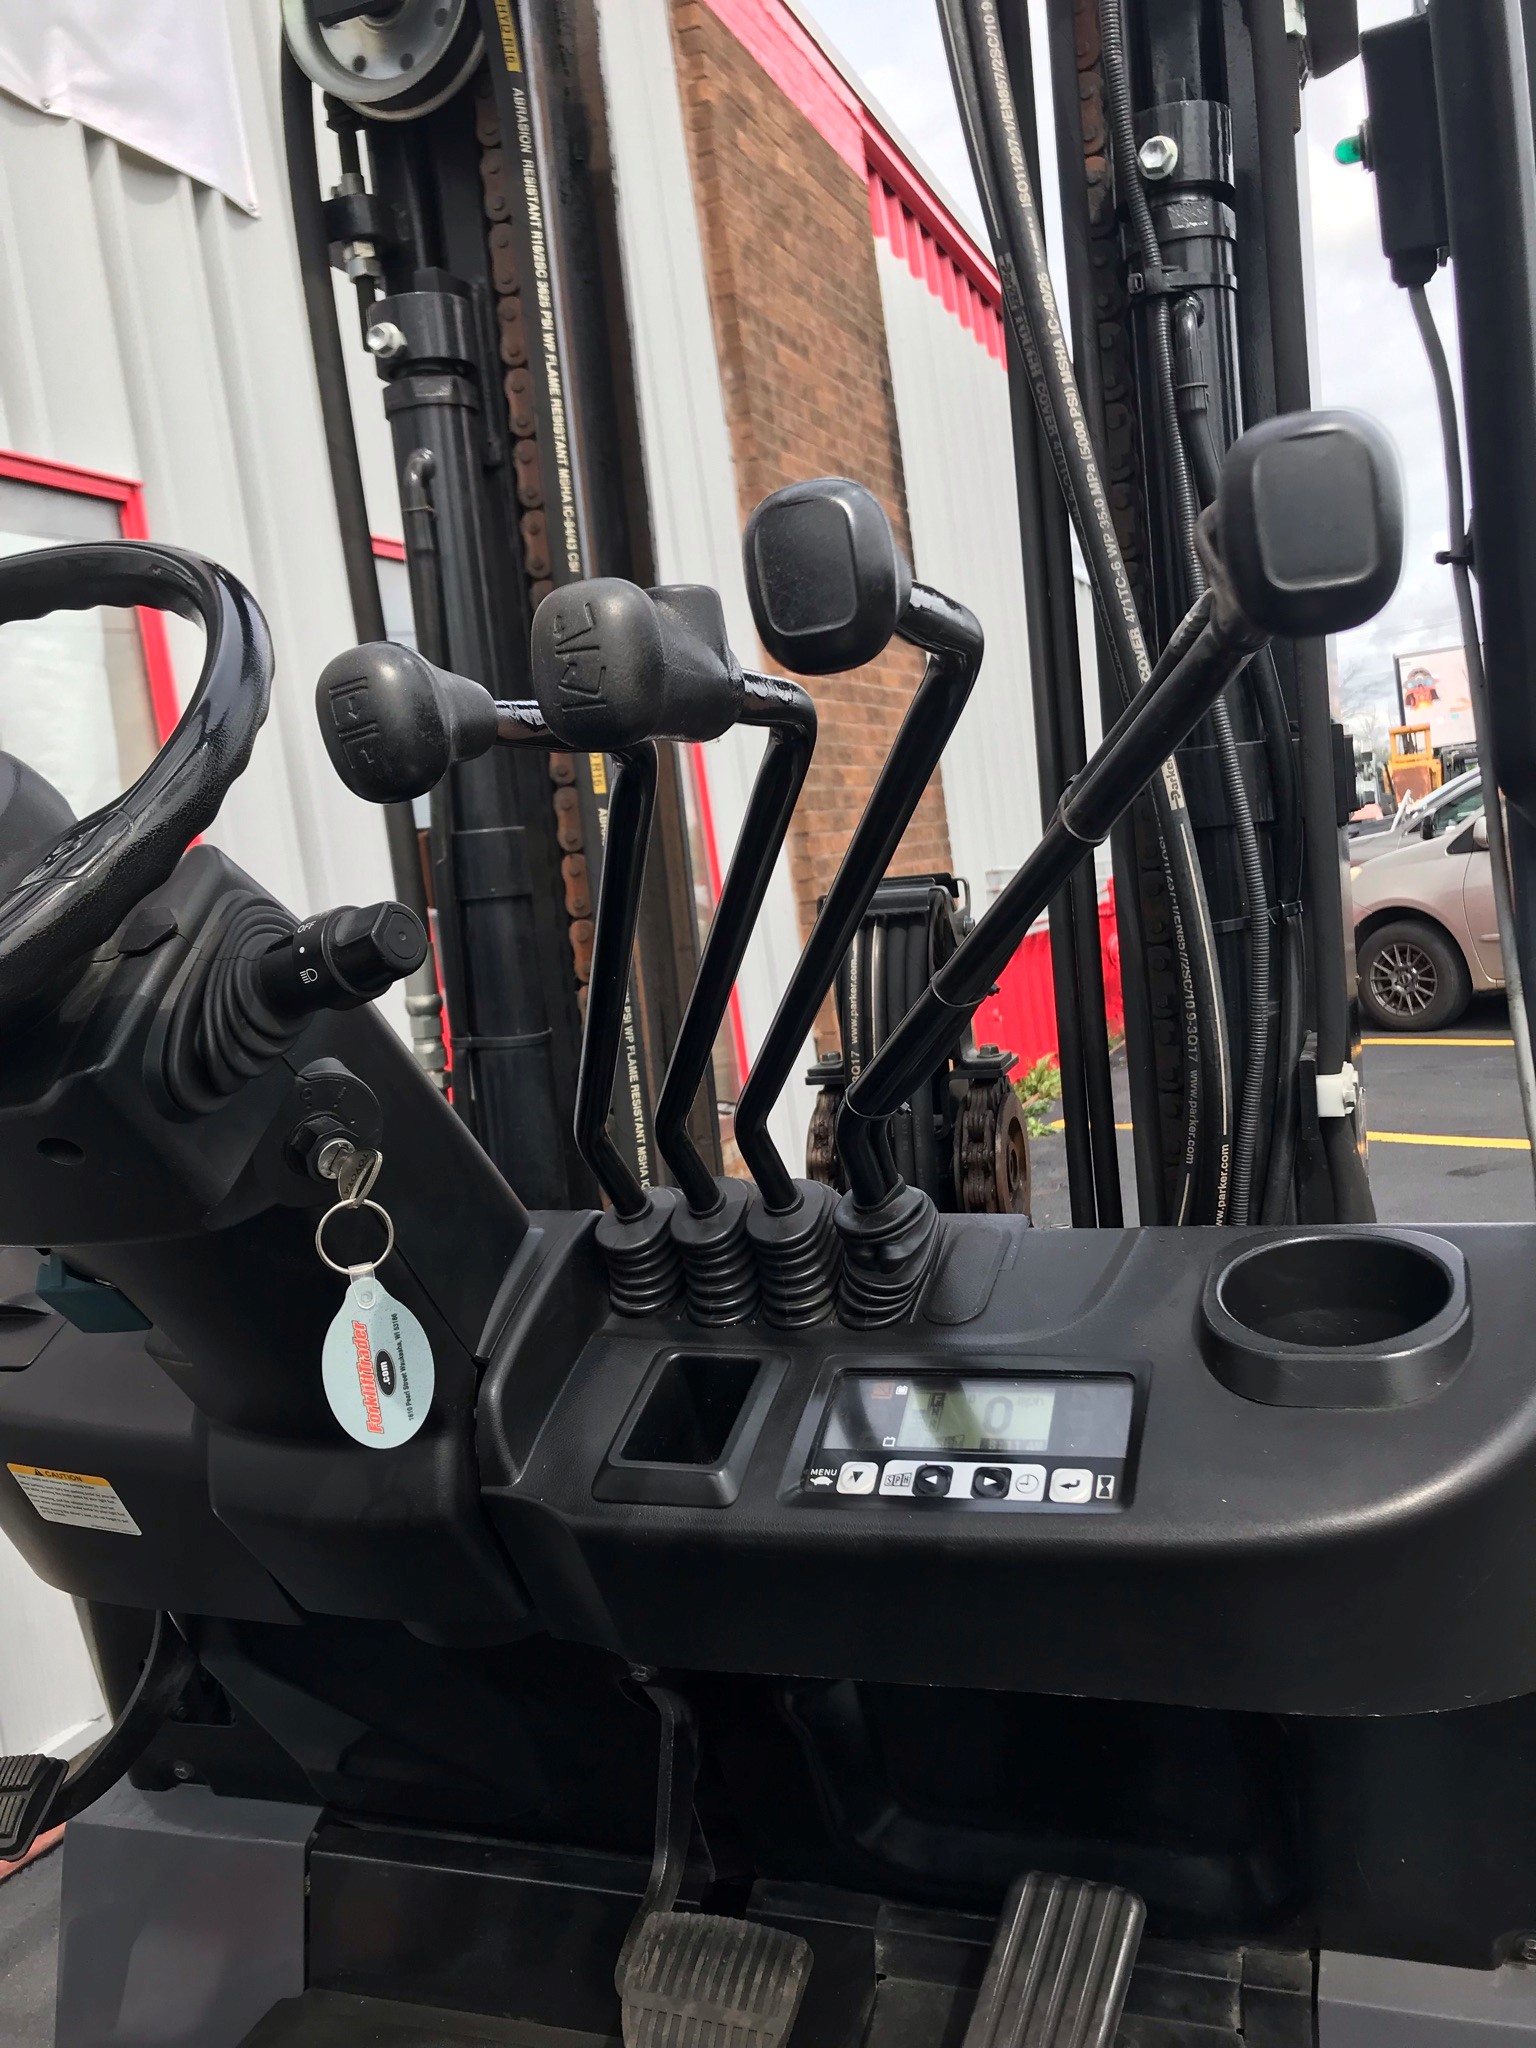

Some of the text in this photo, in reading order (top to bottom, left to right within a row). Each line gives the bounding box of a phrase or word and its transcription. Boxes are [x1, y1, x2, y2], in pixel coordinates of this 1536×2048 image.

[512, 87, 532, 154] ABRASION
[521, 159, 543, 230] RESISTANT
[539, 309, 554, 330] PSI
[542, 331, 557, 353] WP
[545, 353, 562, 398] FLAME
[1052, 337, 1075, 385] MSHA
[1063, 386, 1082, 418] PSI)
[550, 398, 570, 466] RESISTANT
[1073, 420, 1093, 460] (5000
[1086, 463, 1102, 496] MPa
[1093, 498, 1112, 530] 35.0
[1104, 538, 1122, 561] WP
[1109, 561, 1136, 623] 471TC-6
[1128, 627, 1152, 683] COVER
[297, 920, 317, 934] OFF
[848, 959, 860, 1045] www.parker.com
[624, 1025, 635, 1043] WP
[626, 1044, 639, 1082] FLAME
[630, 1083, 646, 1145] RESISTANT
[1185, 1069, 1200, 1165] www.parker.com
[343, 1153, 369, 1195] TOYOTA
[636, 1146, 649, 1177] MSHA
[393, 1331, 401, 1341] WI
[351, 1319, 385, 1434] ForkliftTrader
[401, 1372, 410, 1391] Street
[403, 1390, 413, 1407] Pearl
[44, 1470, 83, 1483] CAUTION
[810, 1468, 838, 1476] MENU
